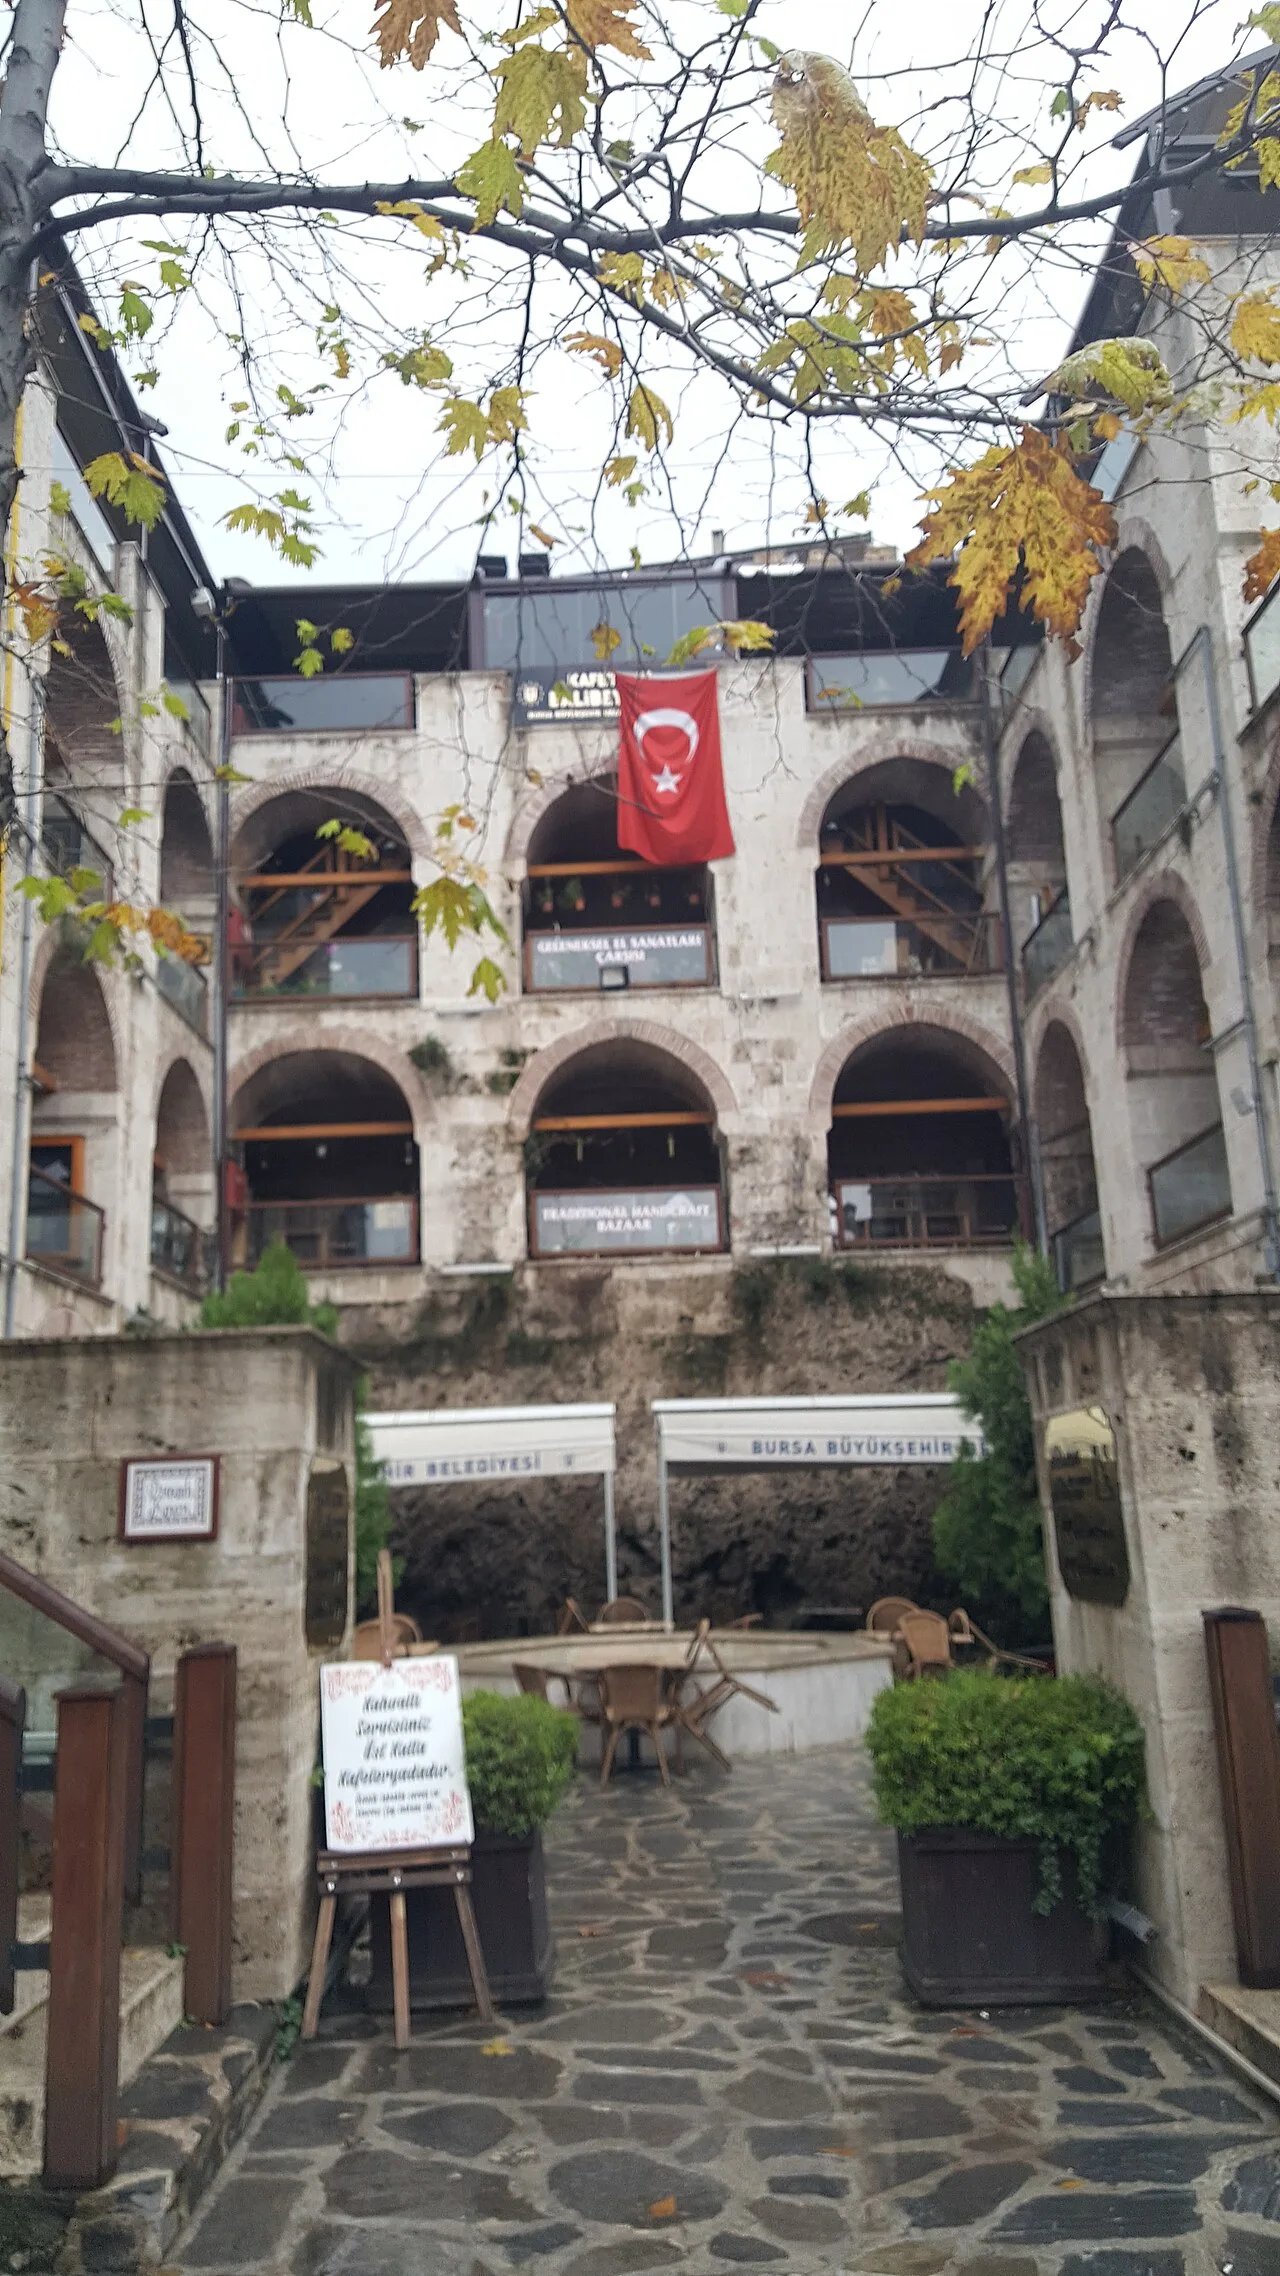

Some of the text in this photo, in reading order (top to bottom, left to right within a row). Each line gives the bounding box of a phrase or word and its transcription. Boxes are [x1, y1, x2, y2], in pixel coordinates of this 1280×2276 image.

[542, 1206, 628, 1221] TRADITIONAL
[596, 1218, 652, 1232] BAZAAR
[752, 1439, 817, 1455] BURSA
[827, 1435, 951, 1457] BÜYÜKŞEHİR
[426, 1452, 541, 1477] BELEDİYESİ
